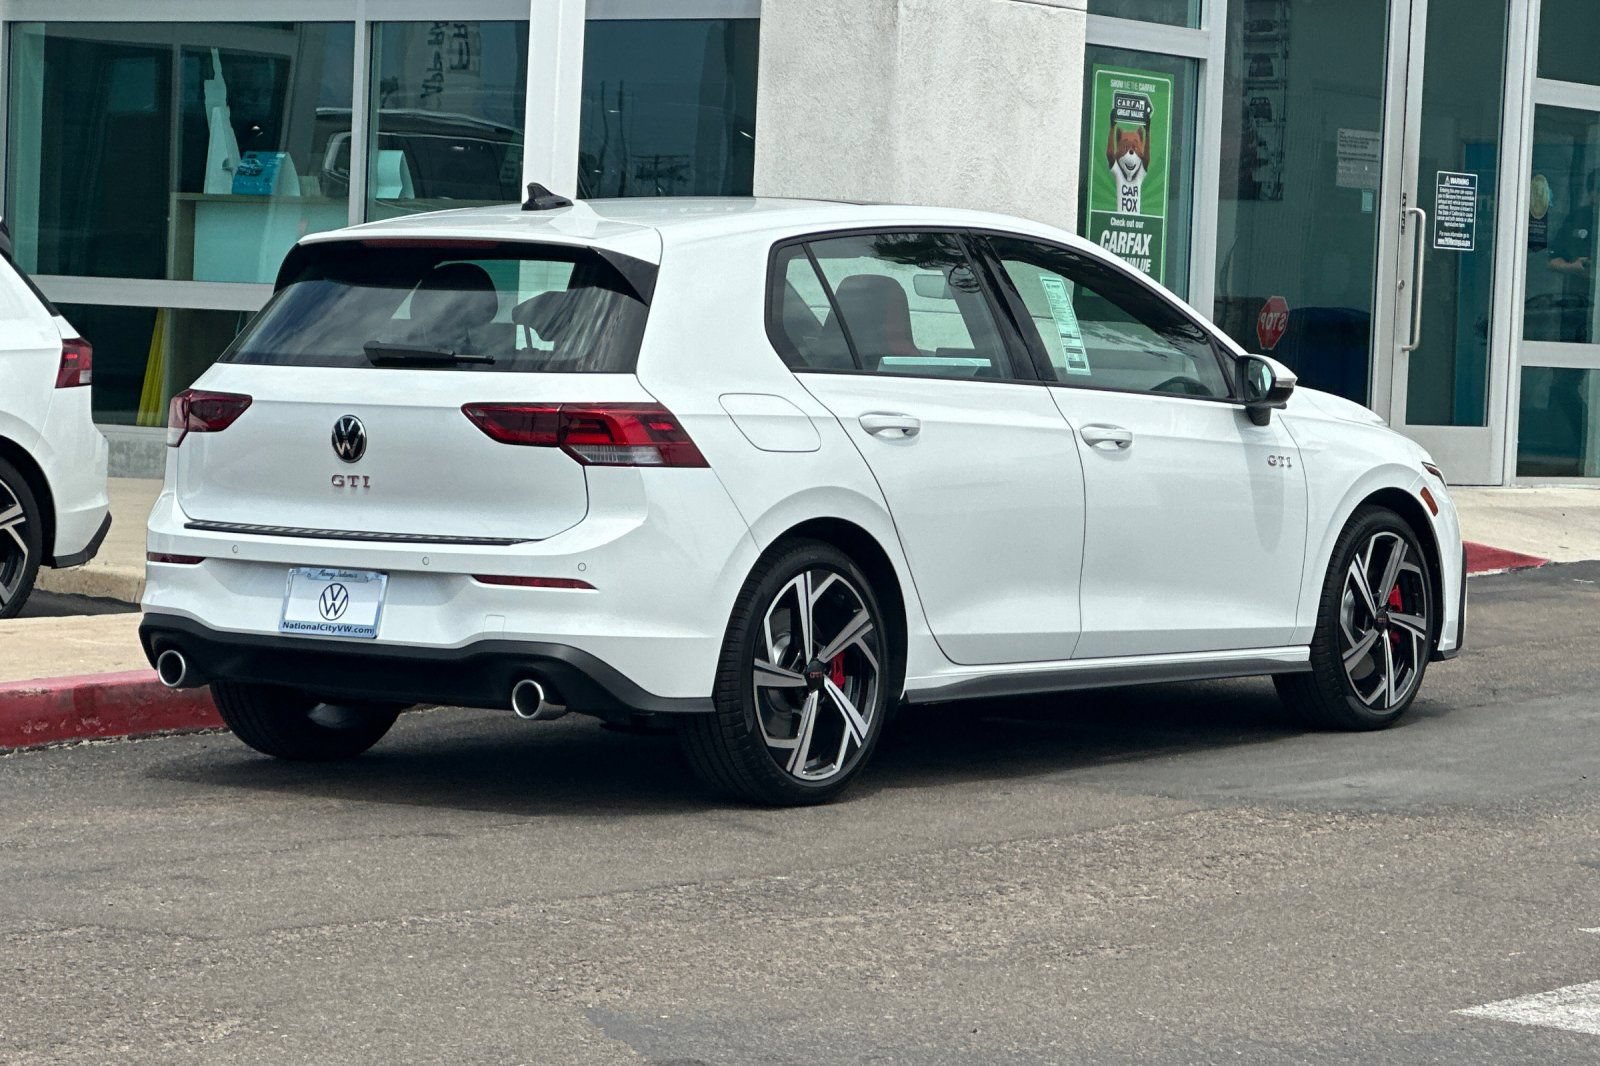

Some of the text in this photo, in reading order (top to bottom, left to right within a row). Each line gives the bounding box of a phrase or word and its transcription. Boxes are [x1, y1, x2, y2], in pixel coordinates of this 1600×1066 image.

[1121, 184, 1139, 197] CAR
[1121, 198, 1138, 213] FOX
[1110, 217, 1145, 229] Check out our
[1100, 229, 1152, 256] CARFAX
[1267, 454, 1292, 468] GTI
[331, 474, 371, 488] GTI
[282, 621, 374, 635] NationalCityVW.com
